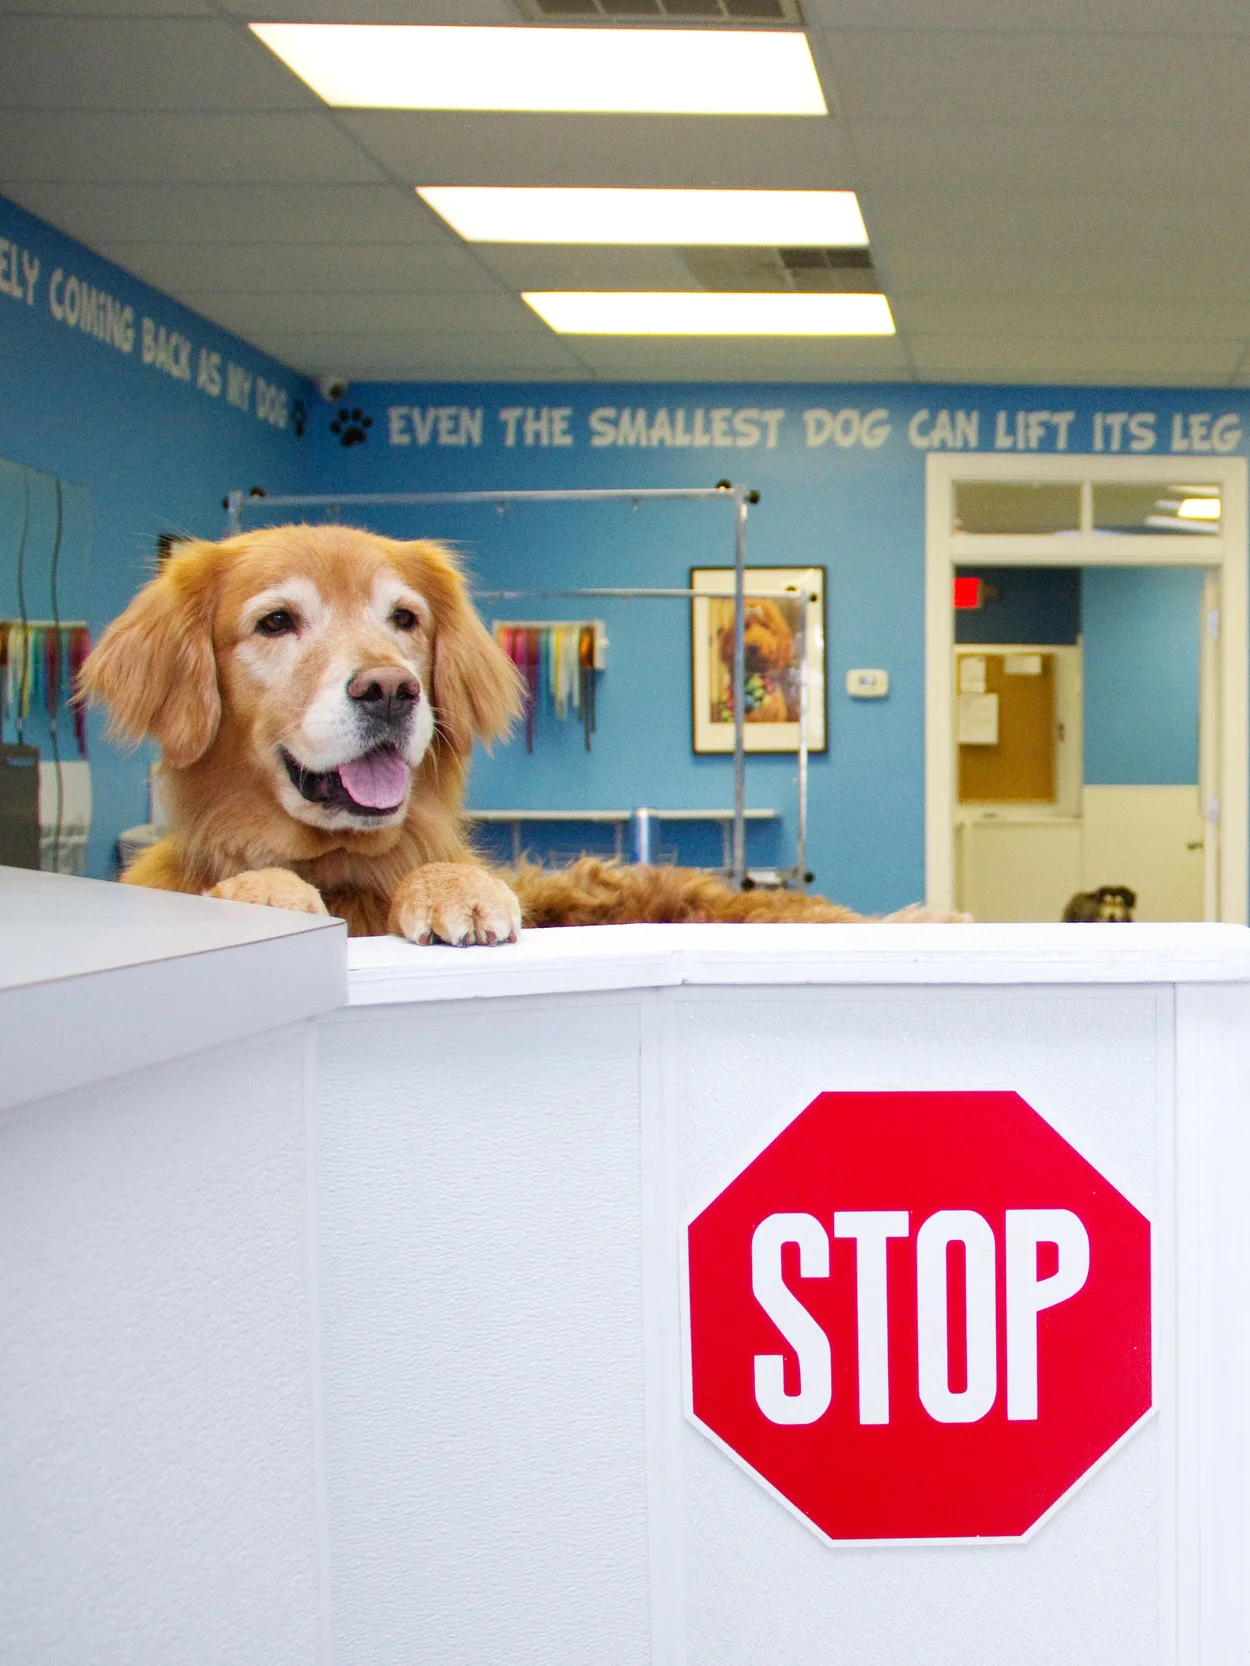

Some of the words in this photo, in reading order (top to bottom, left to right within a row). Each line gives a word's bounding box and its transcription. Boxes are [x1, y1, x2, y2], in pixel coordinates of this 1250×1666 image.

[49, 267, 136, 353] COMING
[141, 317, 192, 383] BACK
[197, 346, 222, 398] IS
[387, 406, 483, 447] EVEN
[500, 407, 573, 448] THE
[590, 407, 784, 448] SMALLEST
[804, 408, 892, 449] DOG
[908, 409, 979, 450] CAN
[995, 410, 1075, 451] LIFT
[1092, 412, 1157, 452] ITS
[1171, 413, 1243, 452] LEG
[751, 1208, 1091, 1426] STOP
